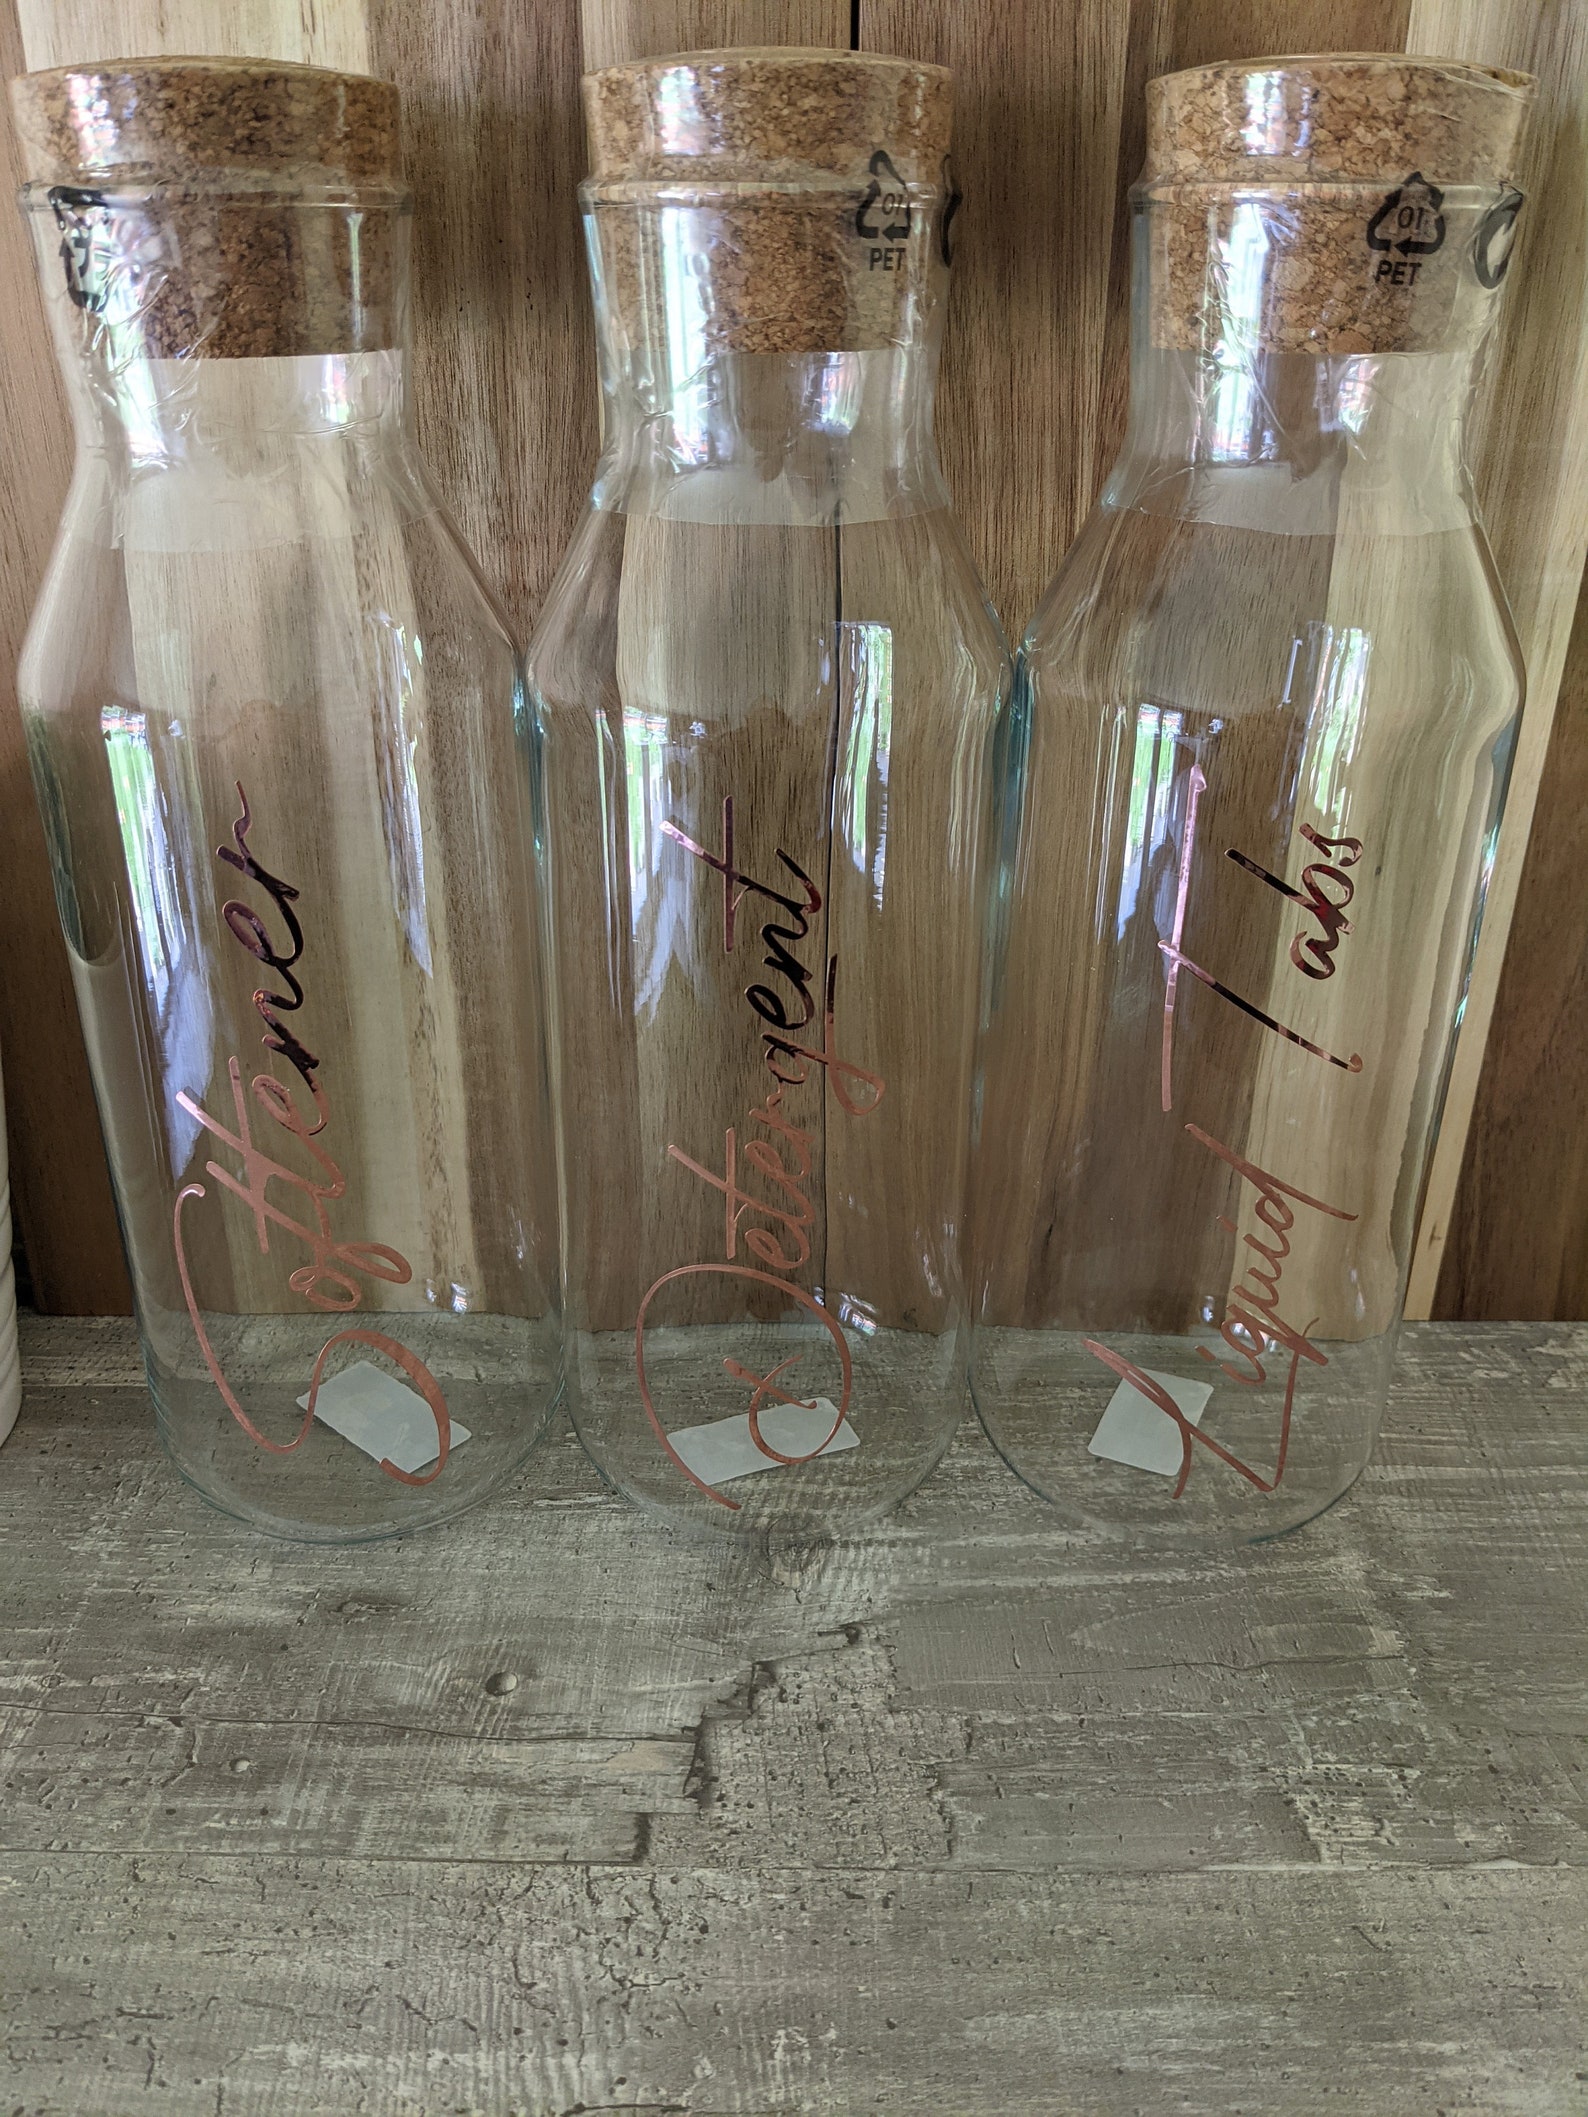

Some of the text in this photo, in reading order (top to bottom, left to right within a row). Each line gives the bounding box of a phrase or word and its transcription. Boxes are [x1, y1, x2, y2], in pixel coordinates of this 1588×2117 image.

[869, 247, 906, 271] PET
[1374, 260, 1422, 286] PET
[174, 779, 449, 1486] Softener
[636, 794, 885, 1510] Detergent
[1081, 763, 1367, 1499] Liquid Tabs
